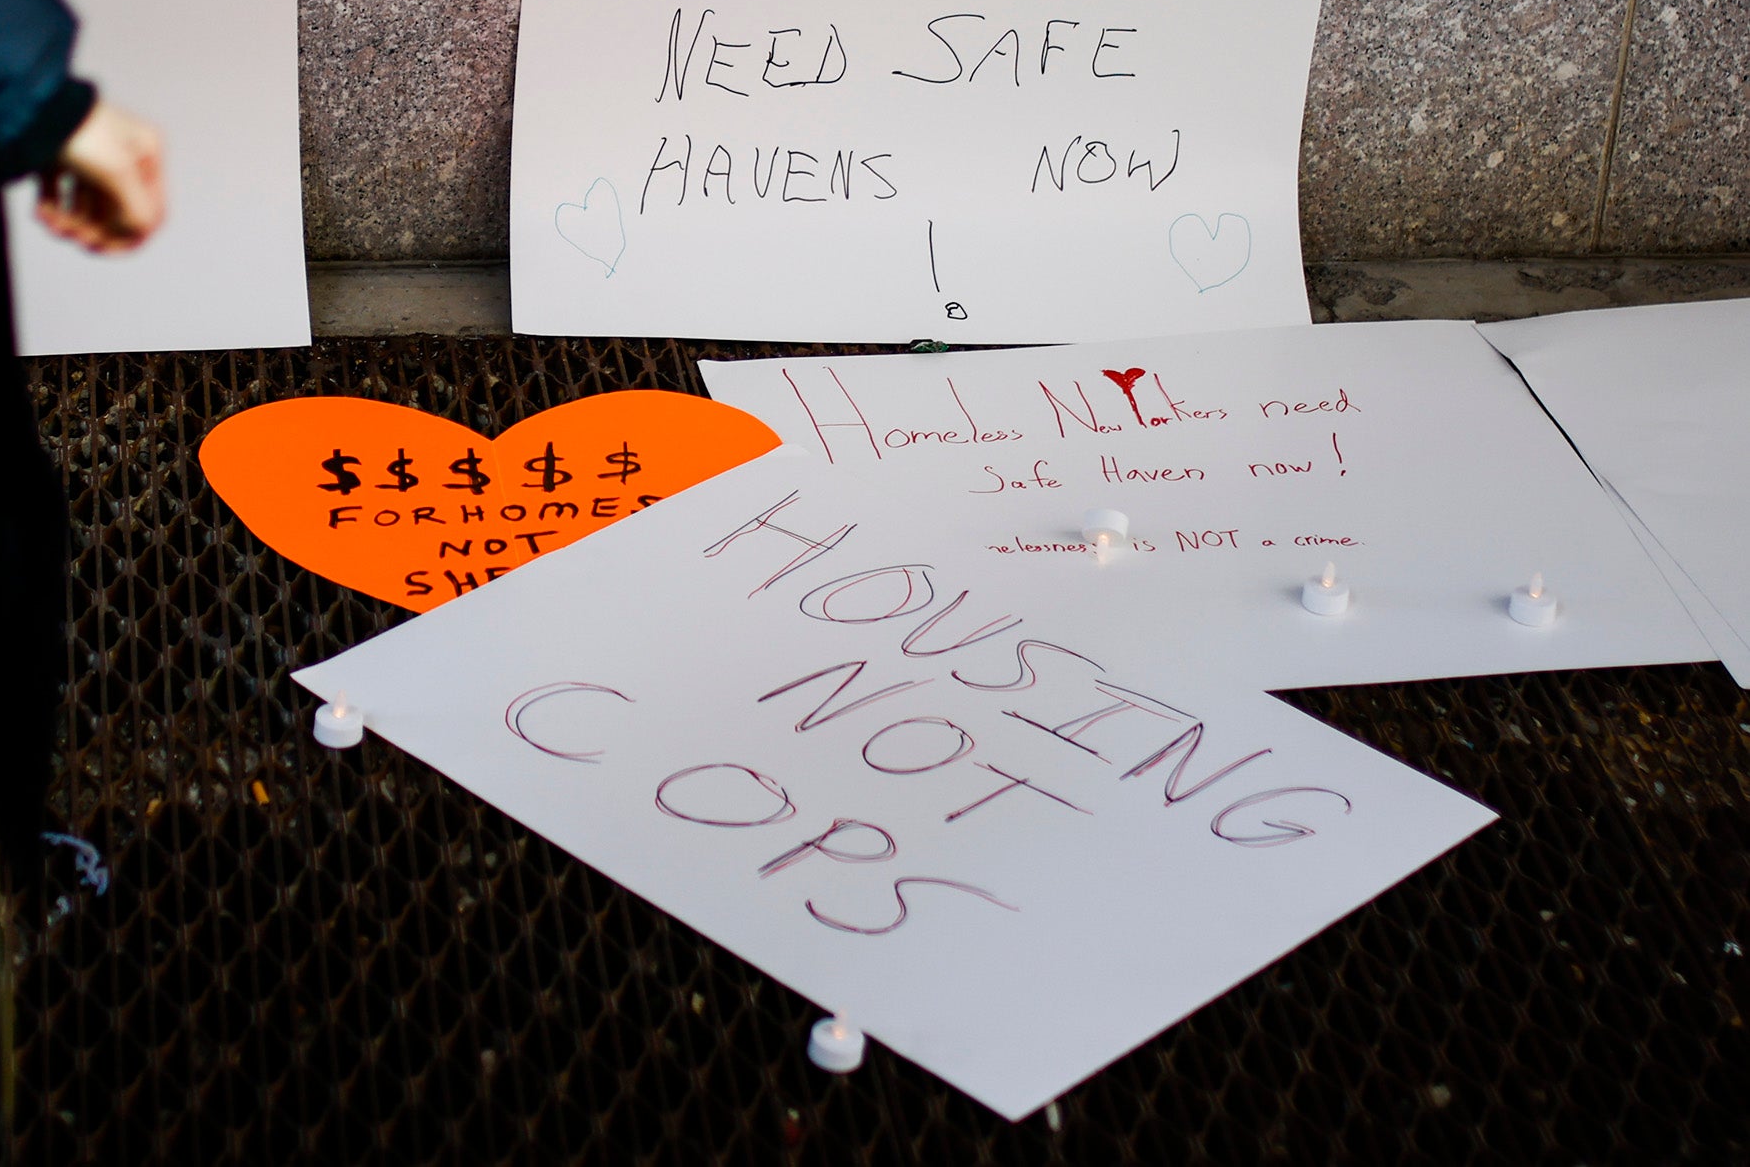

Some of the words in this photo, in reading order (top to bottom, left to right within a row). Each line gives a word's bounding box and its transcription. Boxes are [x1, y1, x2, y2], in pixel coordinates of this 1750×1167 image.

[654, 7, 850, 104] NEED
[892, 13, 1138, 88] SAFE
[640, 135, 899, 215] HAVENS
[1030, 128, 1184, 195] NOW
[782, 366, 1024, 465] Homeless
[1038, 379, 1123, 439] New
[1259, 389, 1363, 419] need
[968, 460, 1064, 495] Safe
[1100, 454, 1207, 484] Haven
[439, 530, 561, 559] NOT
[1132, 538, 1157, 553] is
[1175, 529, 1240, 553] NOT
[1261, 538, 1276, 547] a
[703, 489, 1352, 847] HOUSING
[758, 660, 1094, 823] NOT
[505, 680, 1021, 935] COPS
